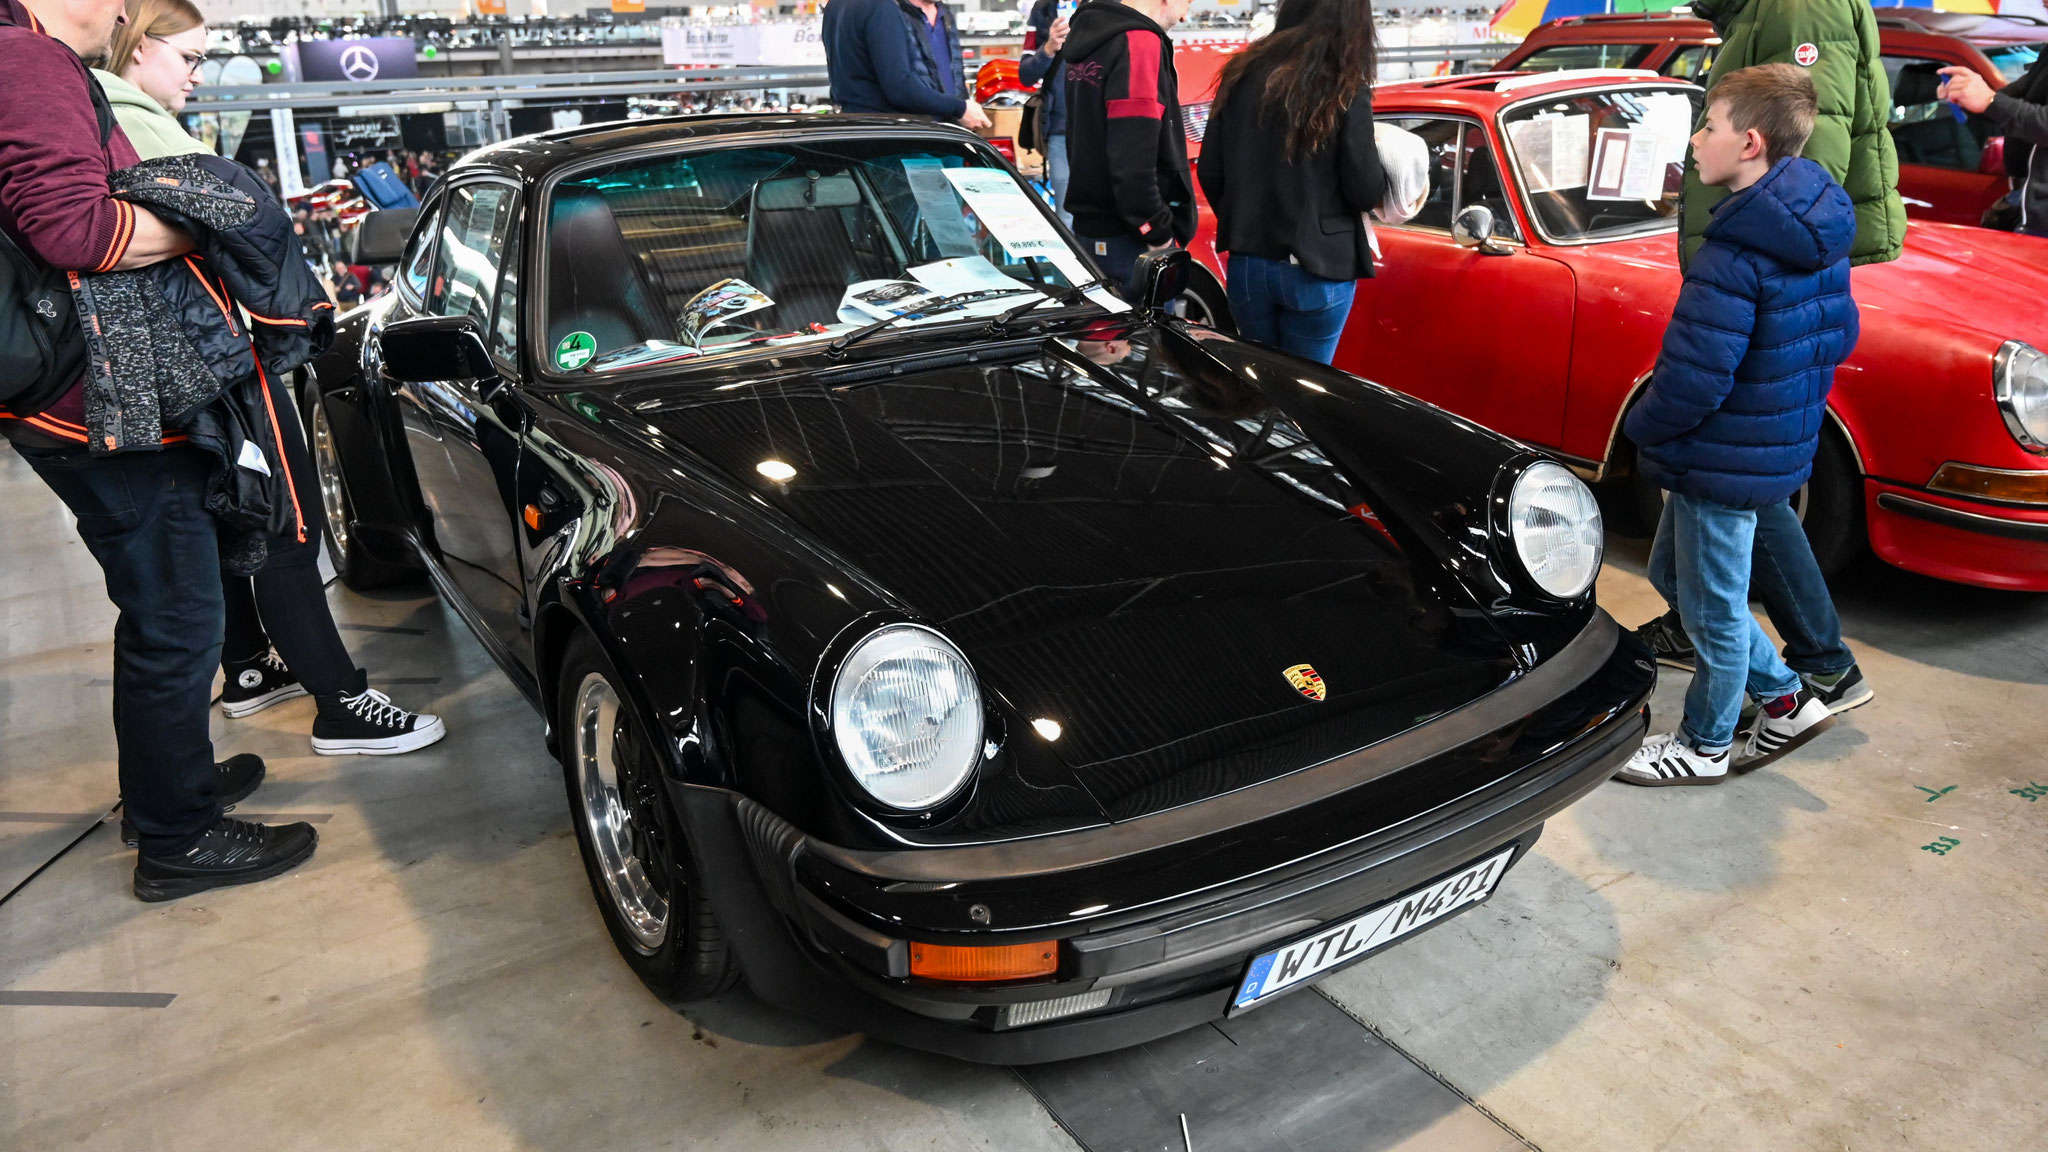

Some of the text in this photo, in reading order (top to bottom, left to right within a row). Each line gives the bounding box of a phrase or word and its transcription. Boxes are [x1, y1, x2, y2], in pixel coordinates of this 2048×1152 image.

[1010, 241, 1036, 249] 99.895
[570, 334, 581, 350] 4
[1245, 981, 1257, 994] D
